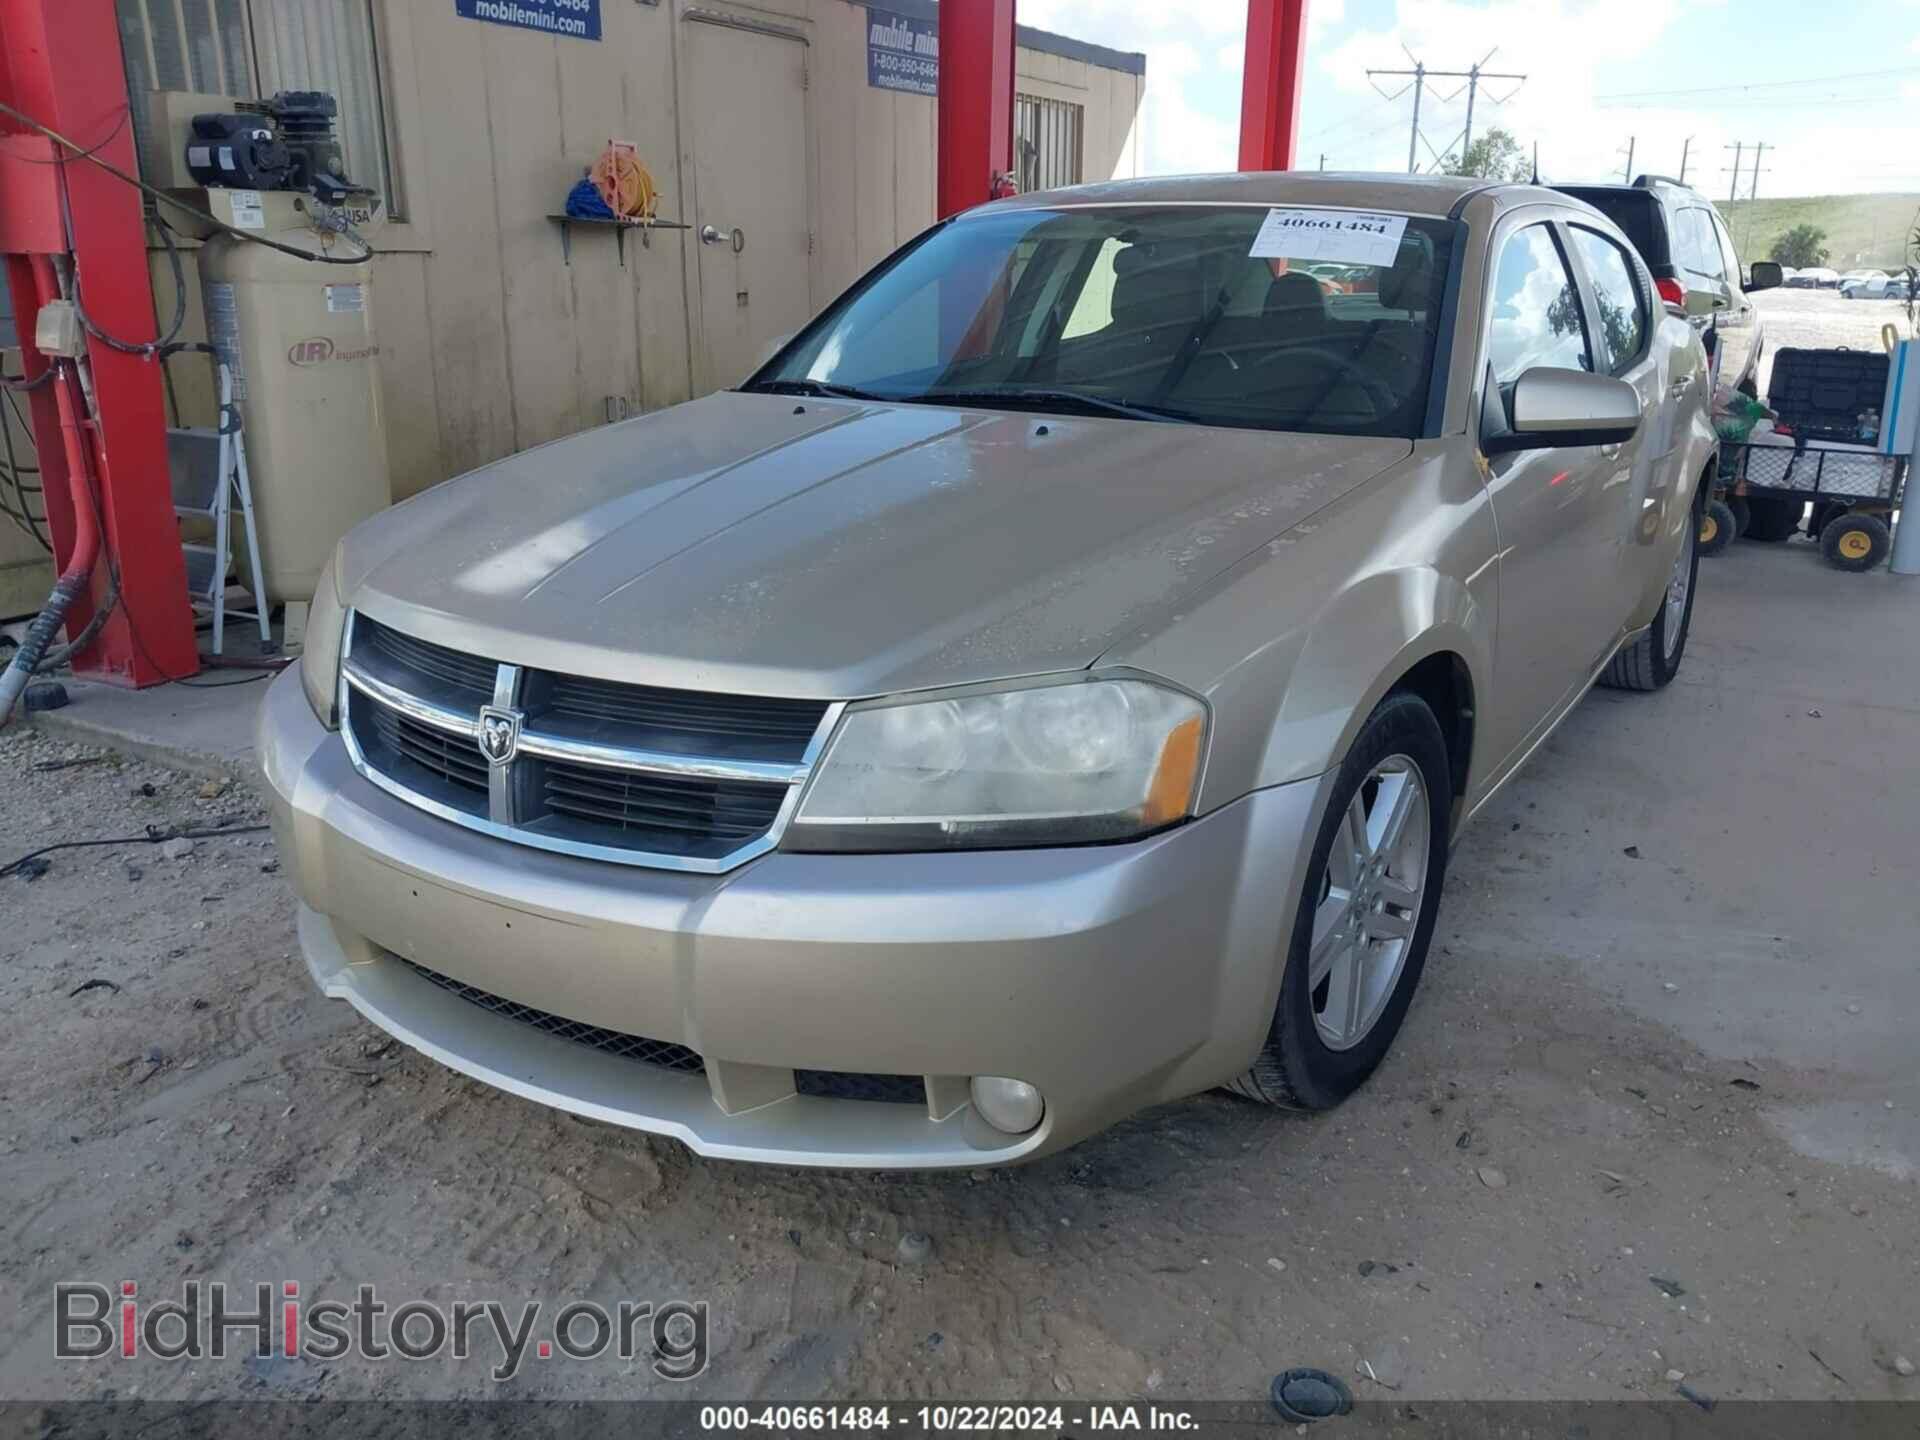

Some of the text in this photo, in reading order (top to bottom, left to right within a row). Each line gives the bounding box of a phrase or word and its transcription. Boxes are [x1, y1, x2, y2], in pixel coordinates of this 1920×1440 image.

[475, 0, 586, 34] mobilemini.com
[870, 17, 939, 57] mobile min
[1278, 218, 1386, 234] 40661484
